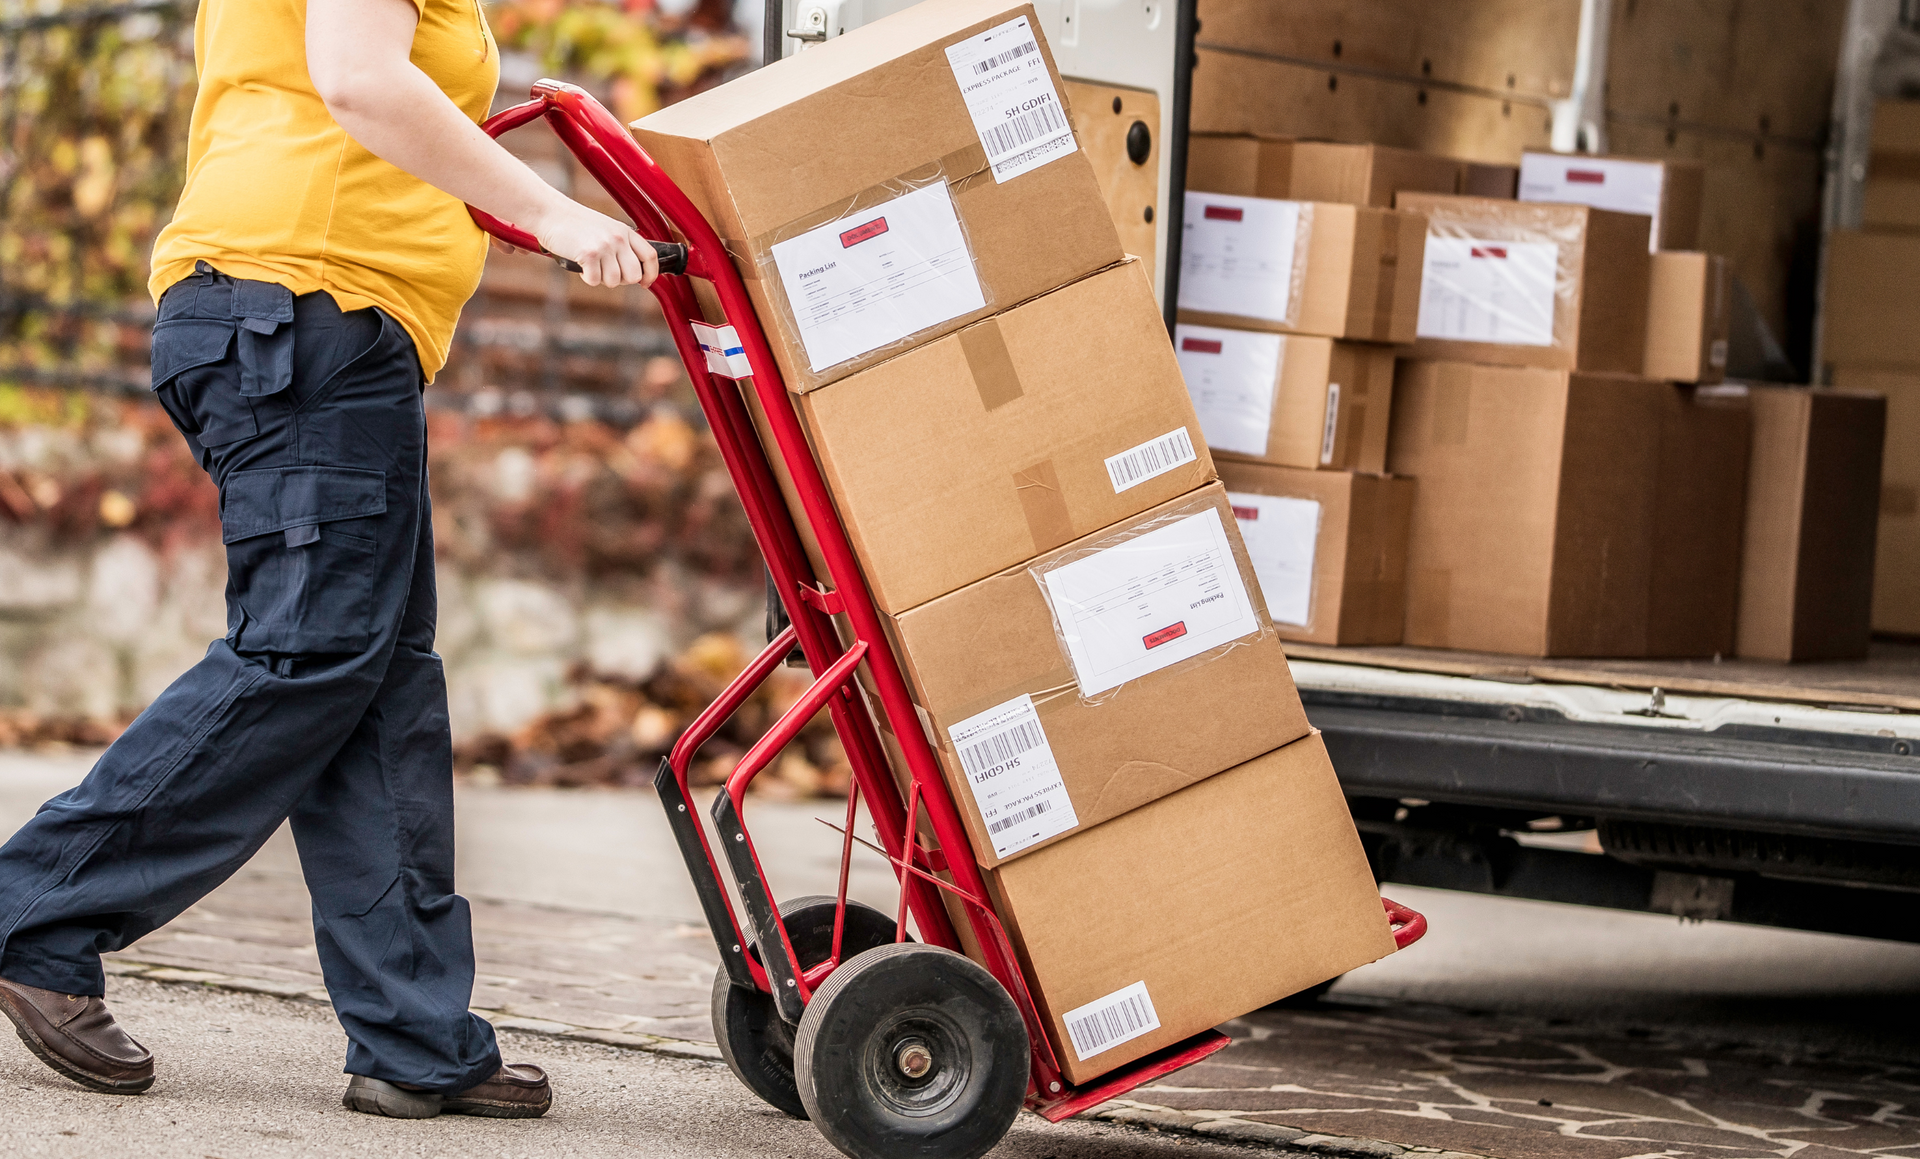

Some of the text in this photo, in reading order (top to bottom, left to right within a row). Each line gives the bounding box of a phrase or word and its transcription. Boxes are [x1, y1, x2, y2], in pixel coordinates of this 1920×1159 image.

[963, 79, 991, 94] EXPRESS
[991, 66, 1020, 82] PACKAGE
[1027, 57, 1040, 67] FFI
[1022, 93, 1051, 111] GDIFI
[799, 261, 836, 279] Packing List
[1190, 592, 1224, 609] Packing List
[1149, 628, 1180, 643] DOCUMENTS
[975, 765, 1004, 783] GDIFI
[1034, 781, 1062, 796] EXPRESS
[1004, 794, 1034, 810] PACKAGE
[985, 808, 997, 818] FFI
